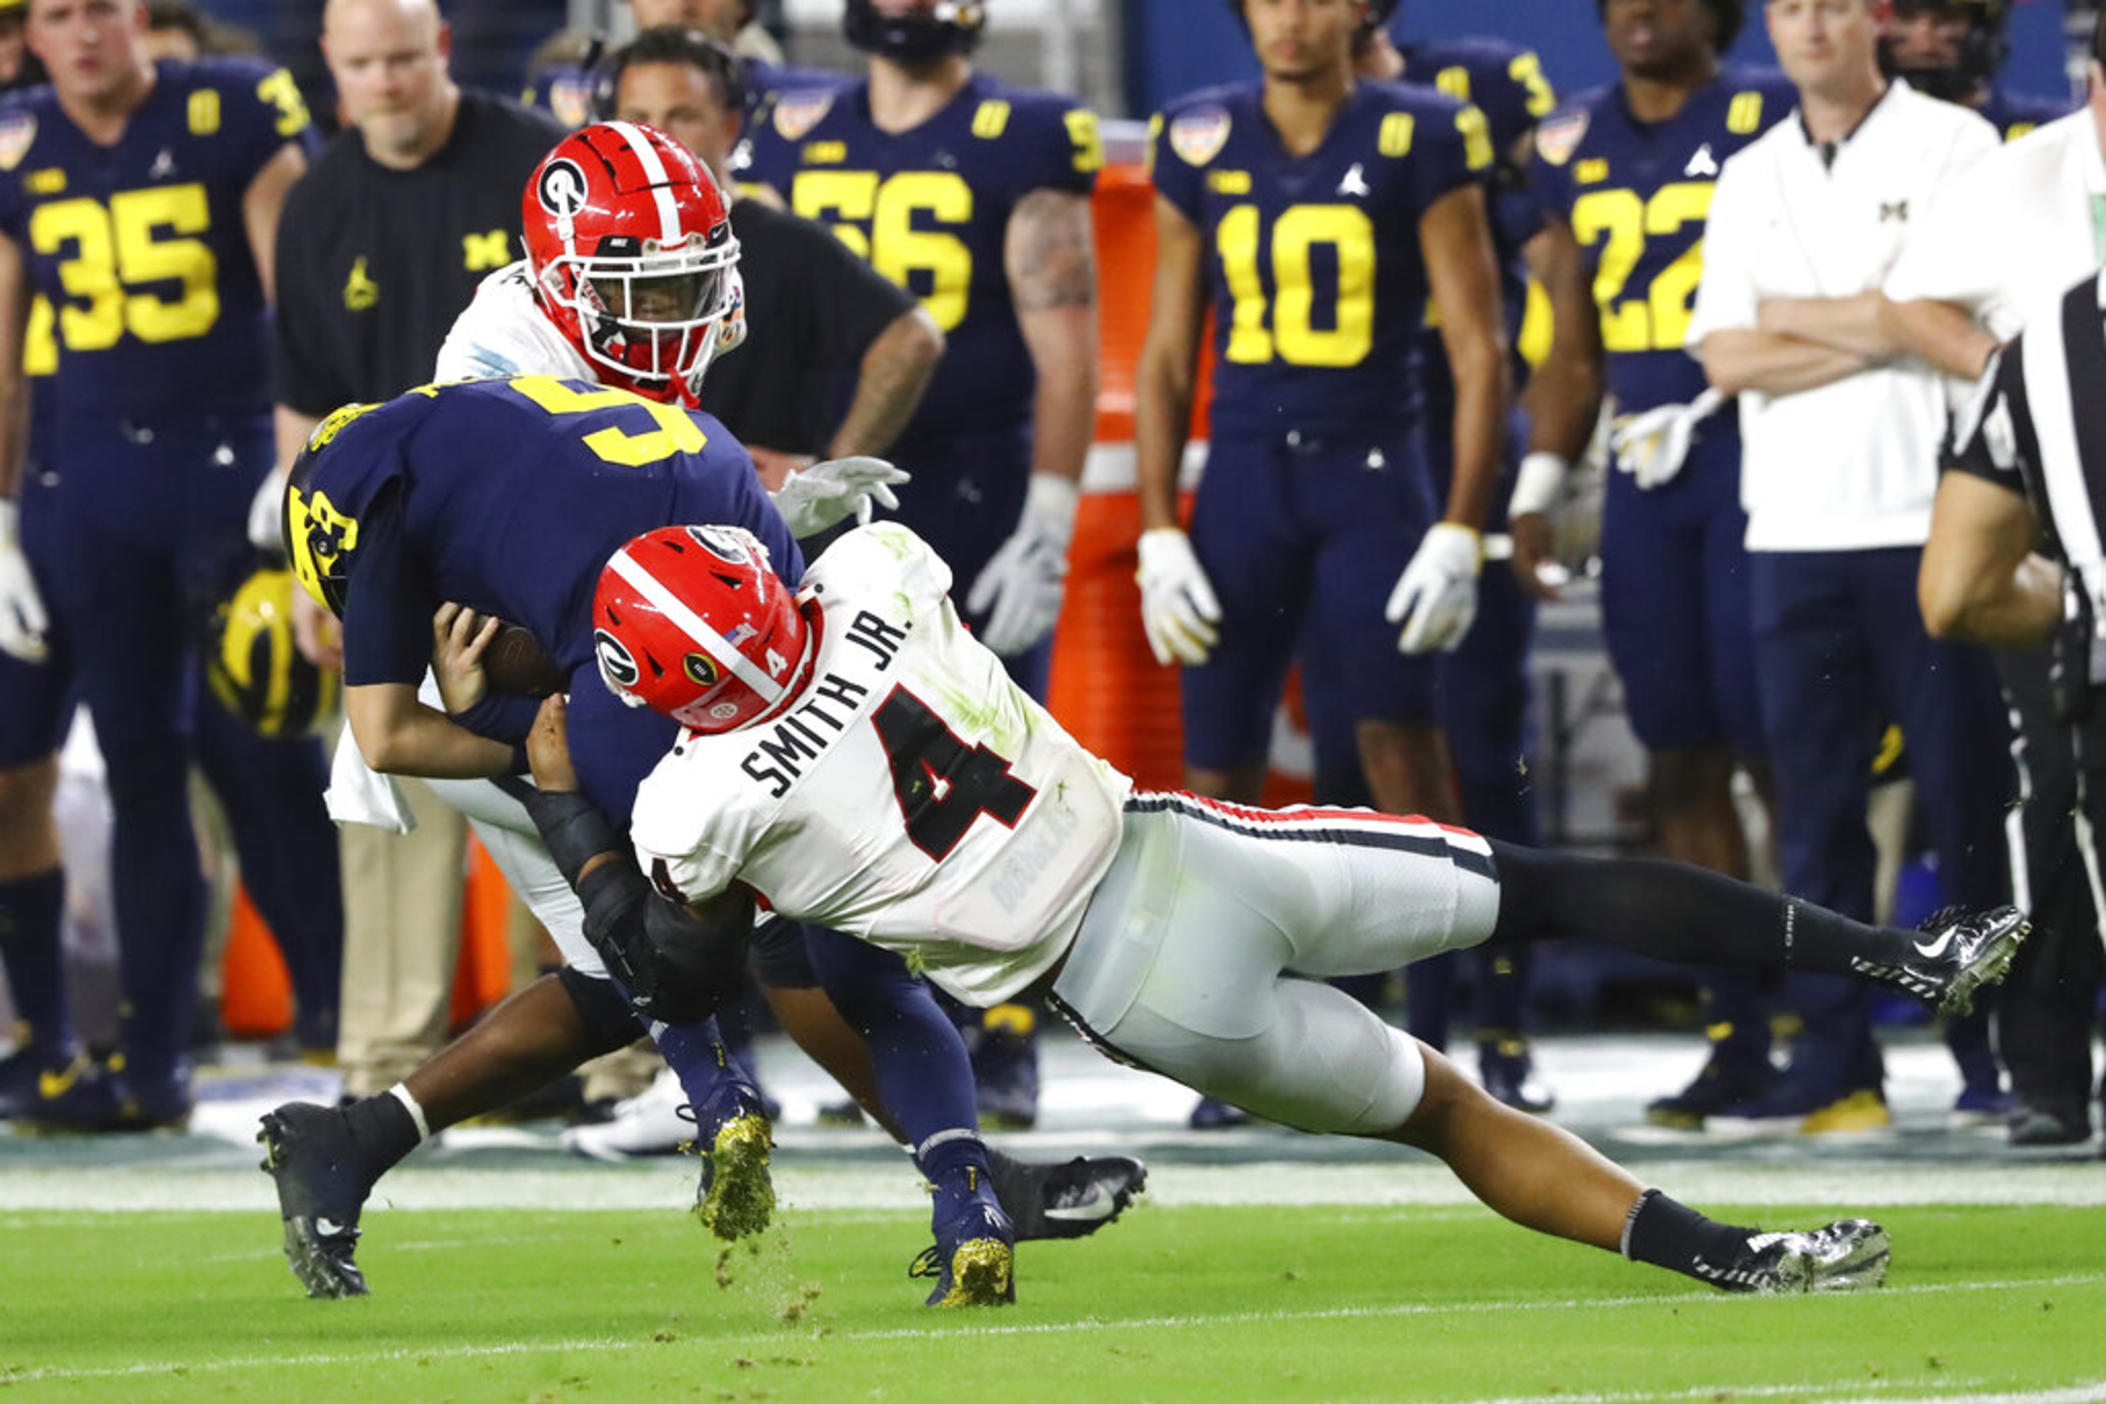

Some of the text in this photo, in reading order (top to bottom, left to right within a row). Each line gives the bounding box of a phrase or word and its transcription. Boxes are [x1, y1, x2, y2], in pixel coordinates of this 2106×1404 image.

[30, 183, 219, 351] 35
[793, 170, 972, 331] 56
[1216, 205, 1374, 366] 10
[741, 611, 912, 798] SMITH JR.
[765, 648, 788, 679] 4
[870, 681, 1037, 863] 4
